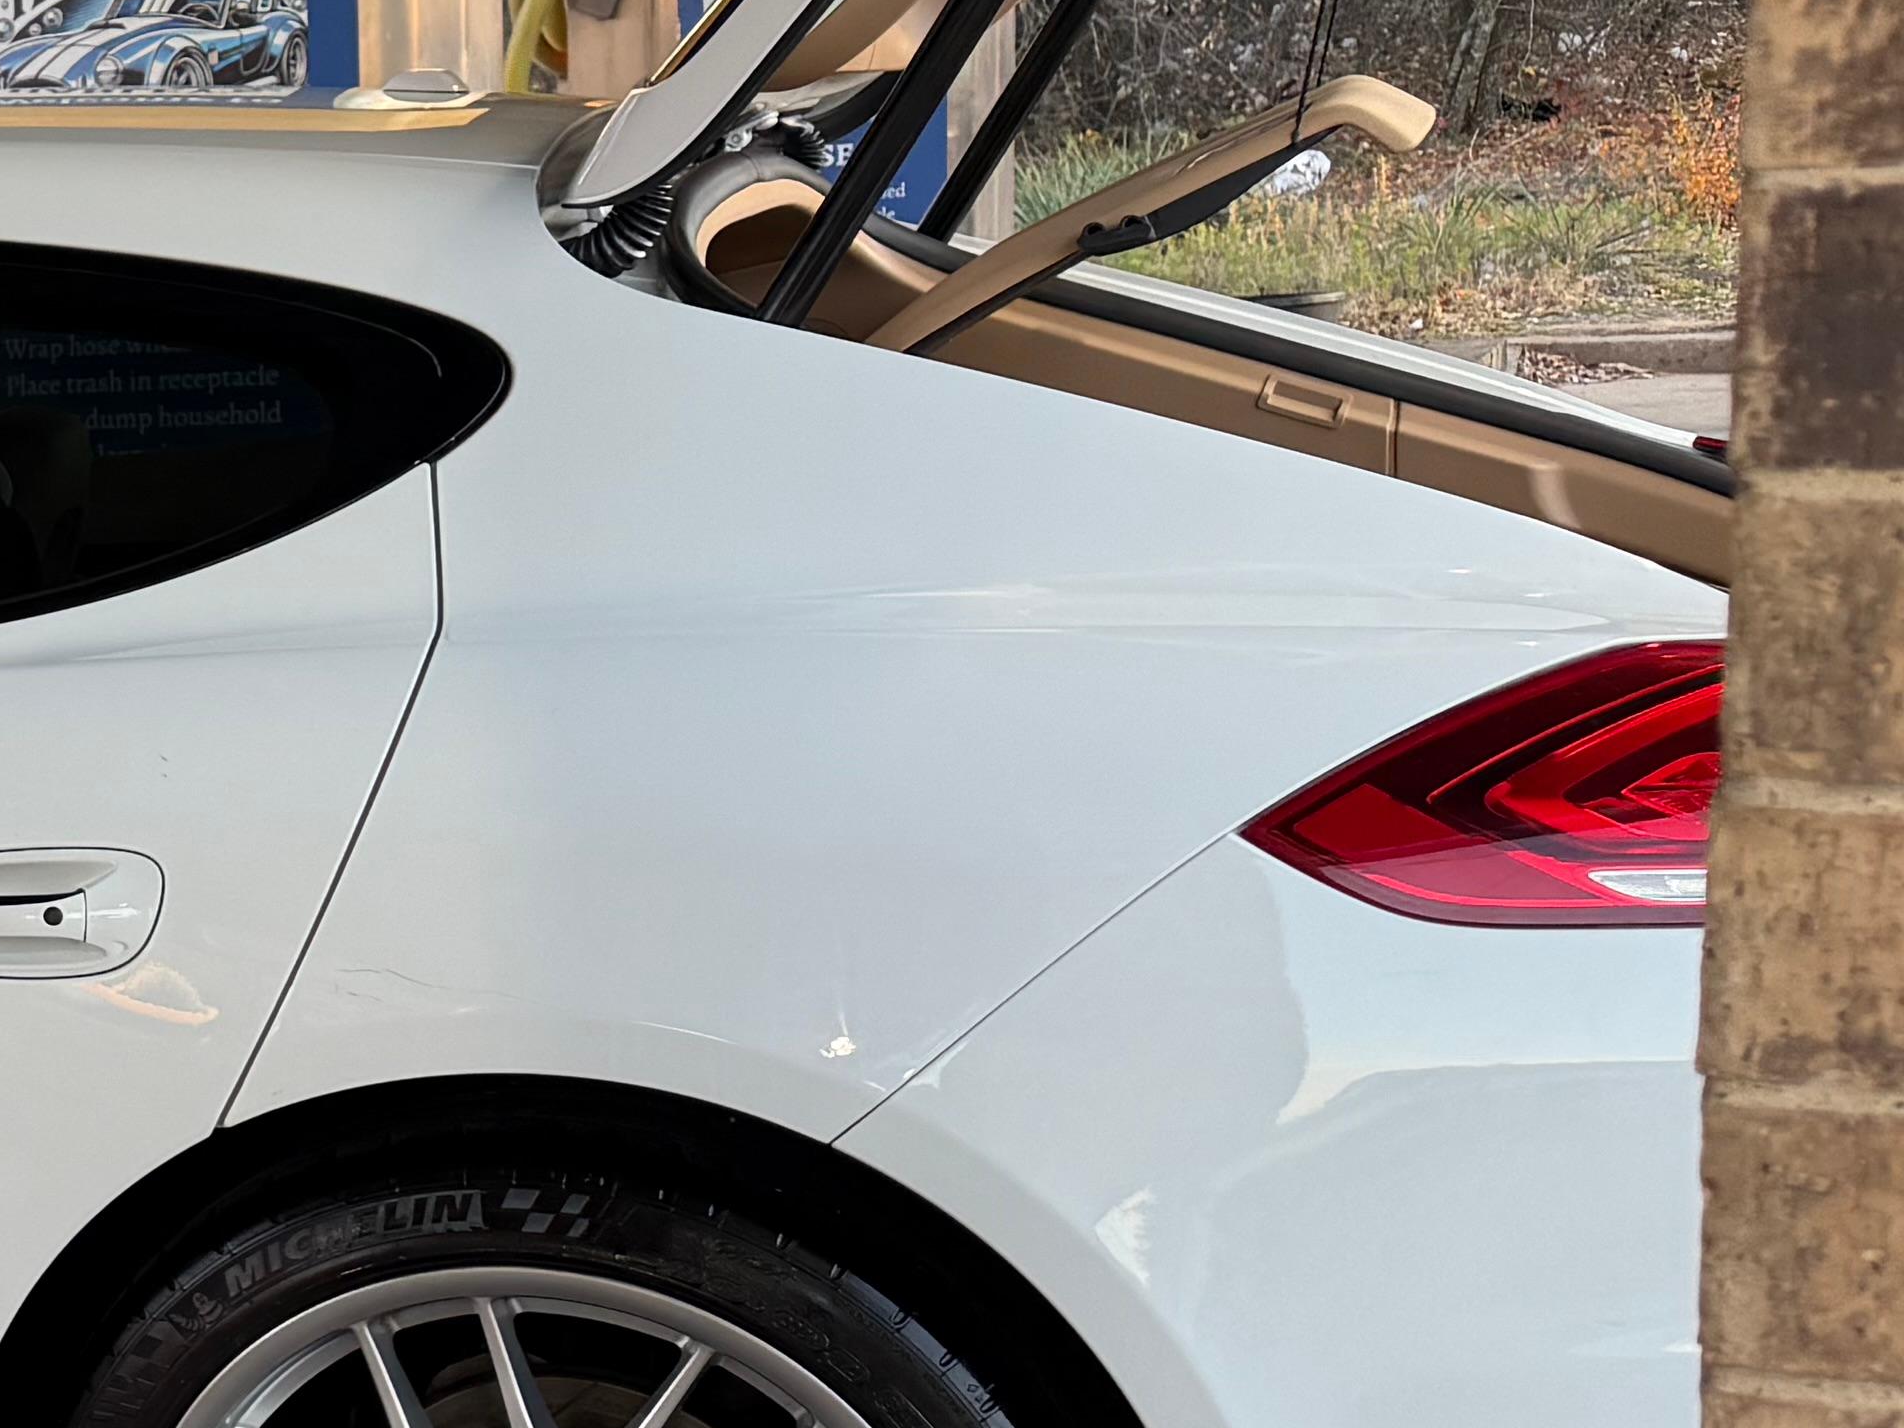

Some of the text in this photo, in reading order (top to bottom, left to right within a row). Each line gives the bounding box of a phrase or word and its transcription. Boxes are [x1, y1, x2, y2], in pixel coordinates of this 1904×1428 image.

[4, 337, 64, 364] Wrap
[68, 333, 121, 356] hose
[6, 363, 281, 398] Place trash in receptacle
[86, 399, 282, 435] dump household
